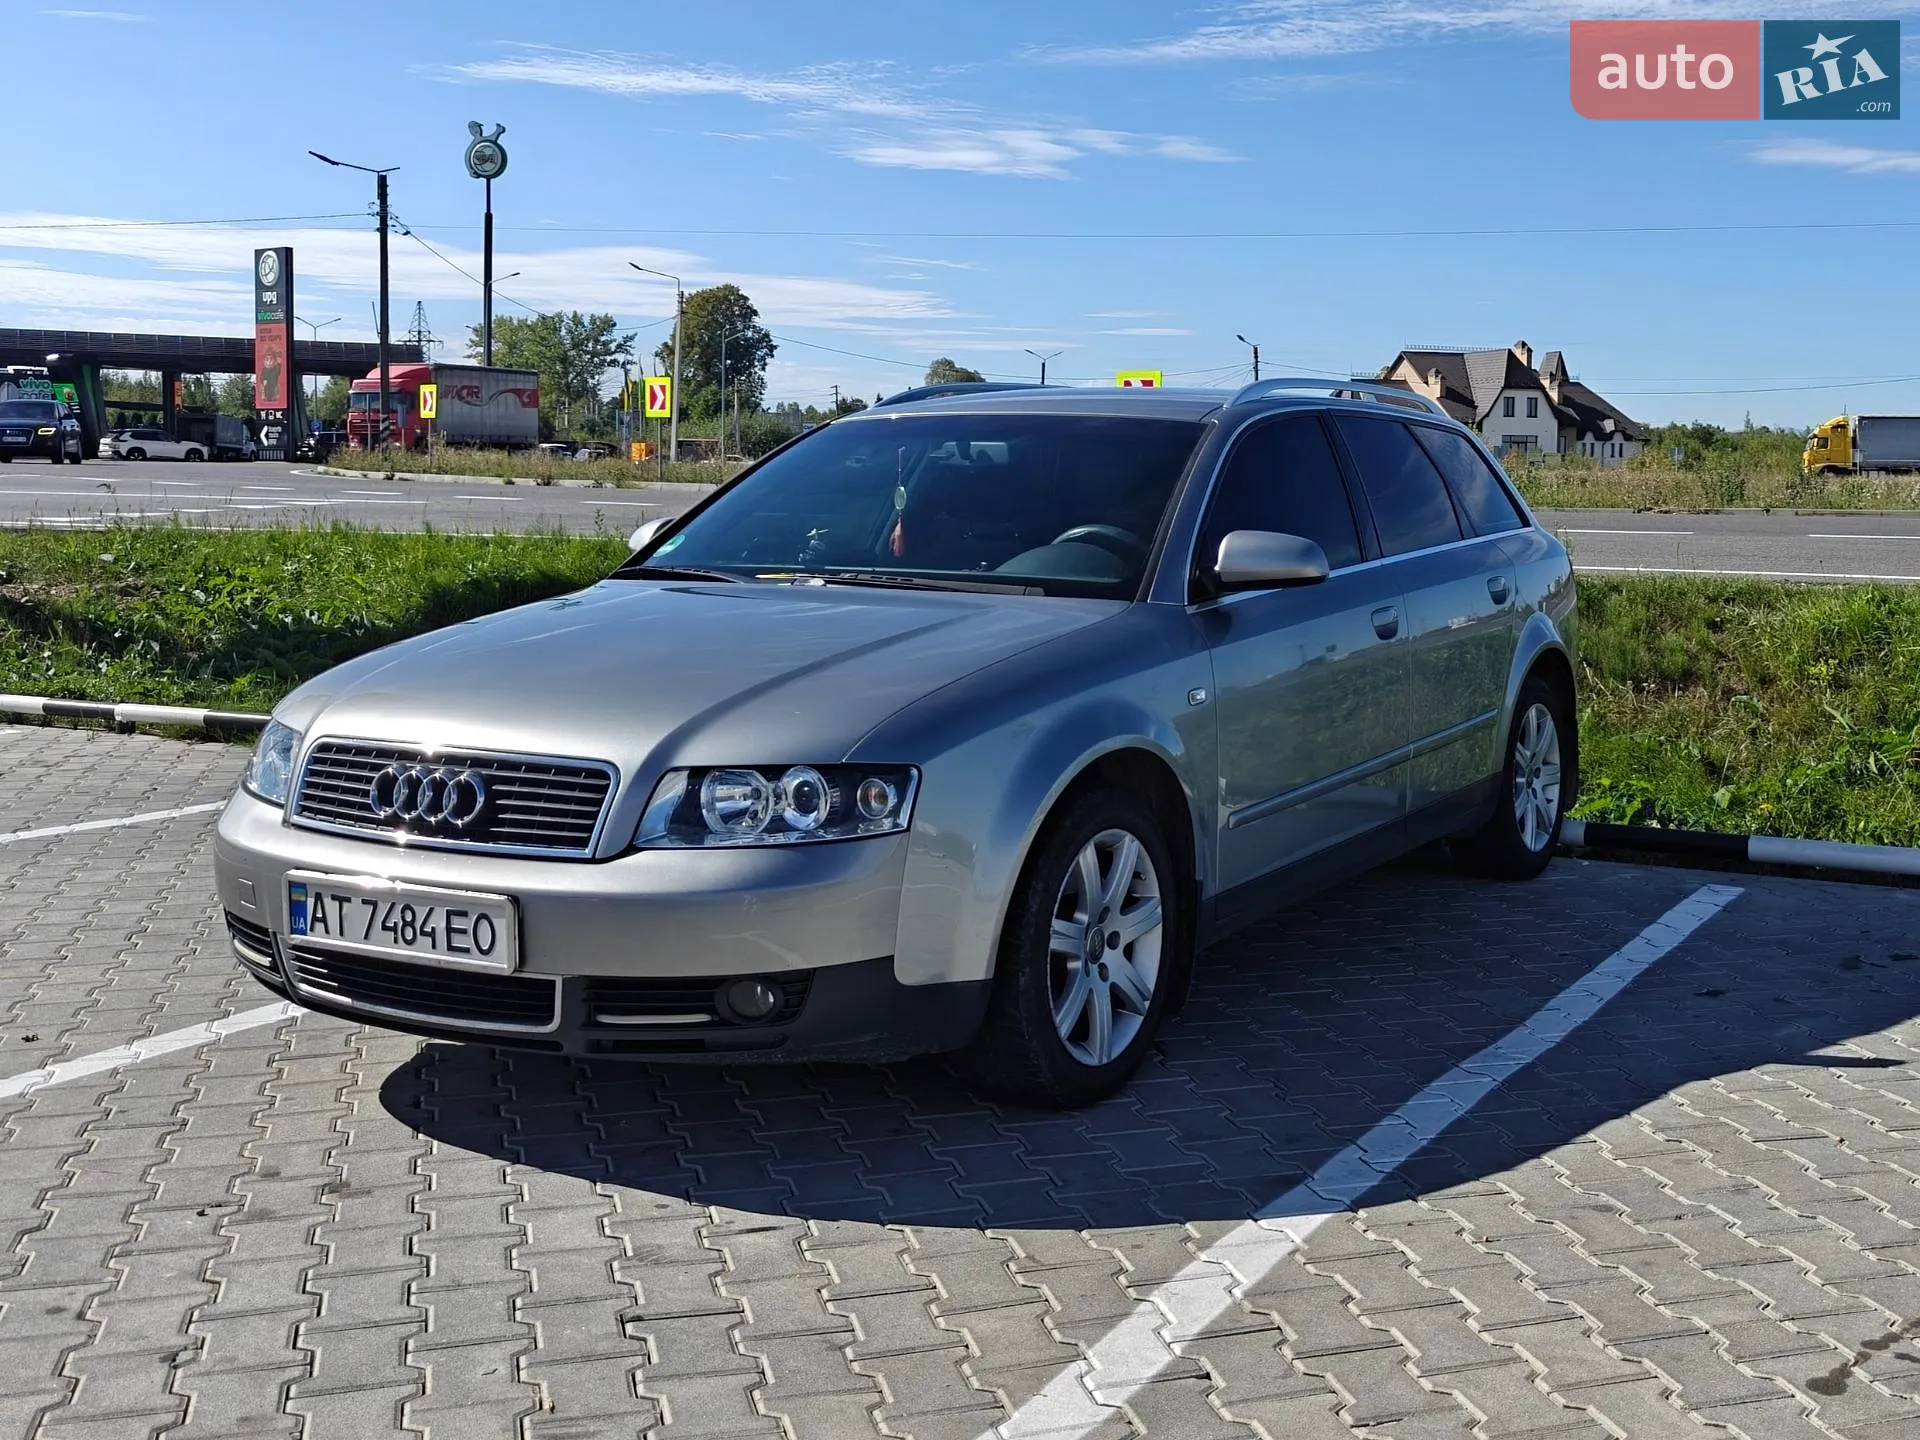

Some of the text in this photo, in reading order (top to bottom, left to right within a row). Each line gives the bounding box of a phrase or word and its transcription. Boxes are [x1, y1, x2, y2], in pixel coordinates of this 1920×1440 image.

[262, 291, 277, 305] upg
[20, 377, 51, 390] vivo
[291, 919, 306, 931] UA
[309, 891, 352, 937] AT
[360, 898, 437, 950] 7484
